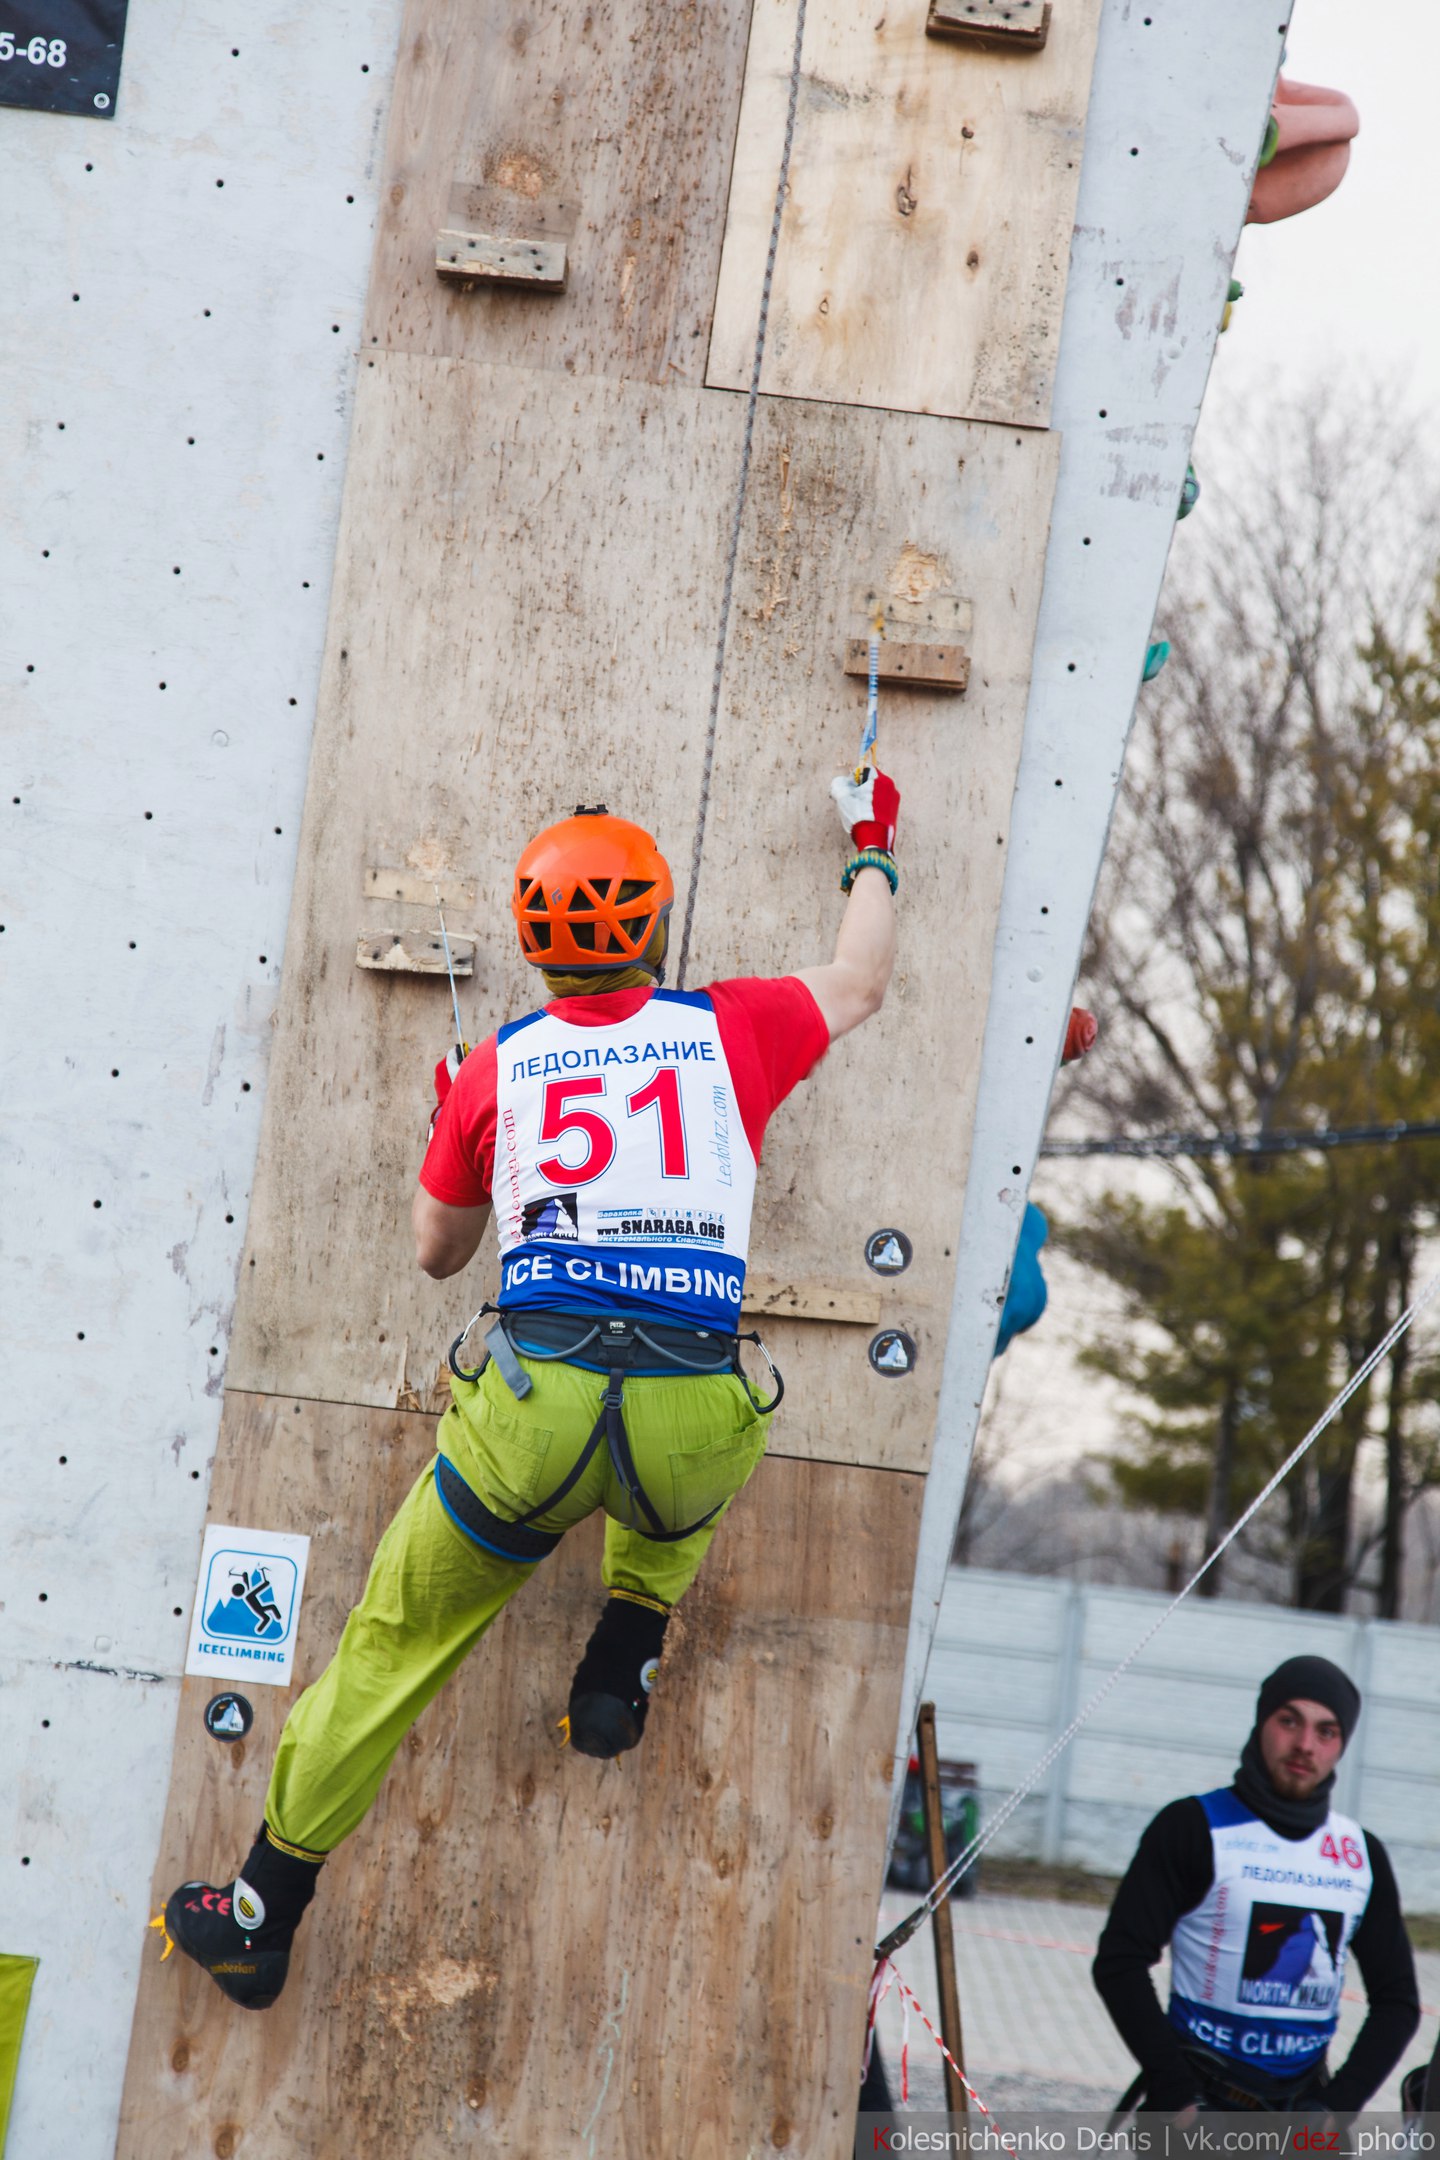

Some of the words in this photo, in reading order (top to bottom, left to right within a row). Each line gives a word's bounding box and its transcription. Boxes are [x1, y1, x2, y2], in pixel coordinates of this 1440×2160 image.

[0, 32, 67, 68] 5-68
[511, 1041, 716, 1082] ЛЕДОЛАЗАНИЕ
[535, 1066, 689, 1188] 51
[708, 1086, 732, 1187] Ledolaz.com
[506, 1254, 553, 1291] ICE
[565, 1258, 741, 1304] CLIMBING
[198, 1643, 285, 1663] ICECLIMBING
[1320, 1833, 1363, 1869] 46
[1242, 1865, 1353, 1889] ЛЕДОЛАЗАНИЕ
[1241, 1979, 1292, 2006] NORTH
